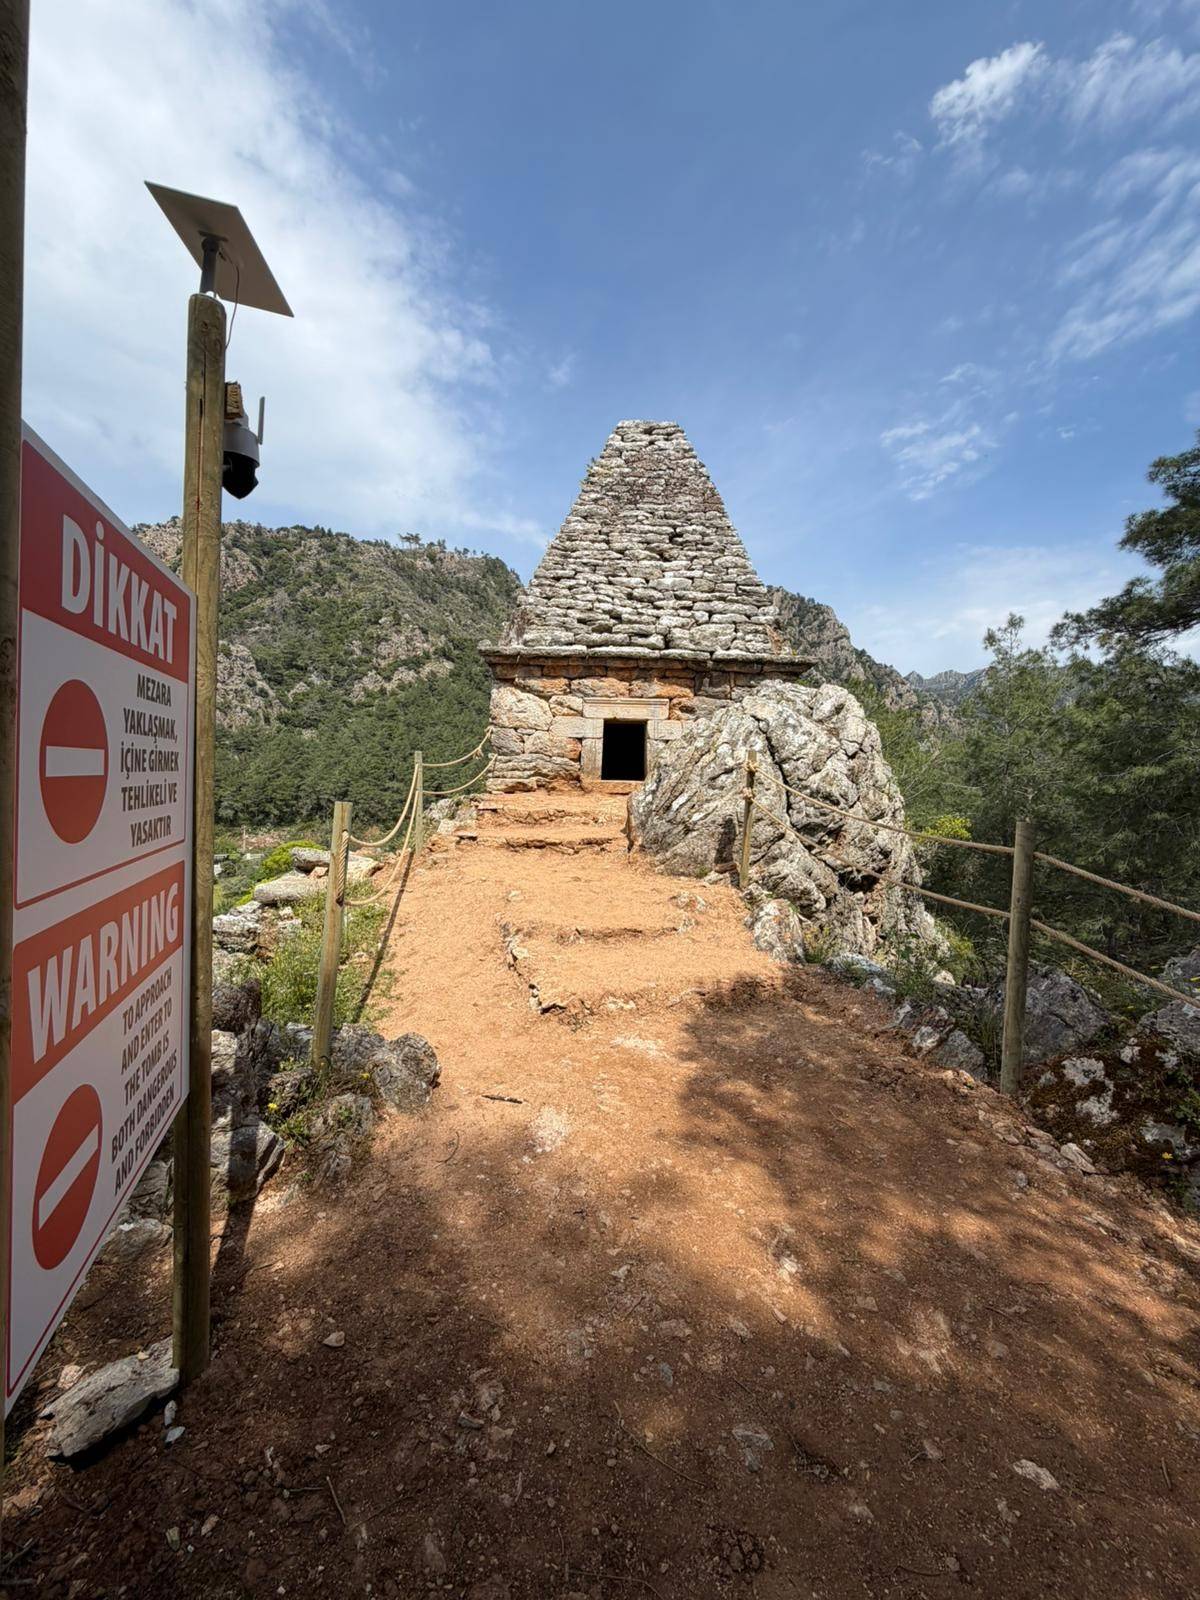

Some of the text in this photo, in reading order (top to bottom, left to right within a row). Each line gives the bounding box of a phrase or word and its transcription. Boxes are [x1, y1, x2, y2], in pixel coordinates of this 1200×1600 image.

[61, 514, 177, 664] DİKKAT
[123, 708, 178, 743] YAKLAŞMAK,
[136, 674, 171, 707] MEZARA
[120, 742, 179, 780] İÇİNE GİRMEK
[121, 779, 178, 812] TEHLİKELİ VE
[130, 815, 172, 847] YASAKTIR
[27, 882, 178, 1064] WARNING
[122, 966, 172, 1035] TO APPROACH
[121, 997, 172, 1075] AND ENTER TO
[124, 1030, 170, 1106] THE TOMB IS
[111, 1048, 178, 1162] BOTH DANGEROUS
[114, 1081, 175, 1196] AND FORBIDDEN
